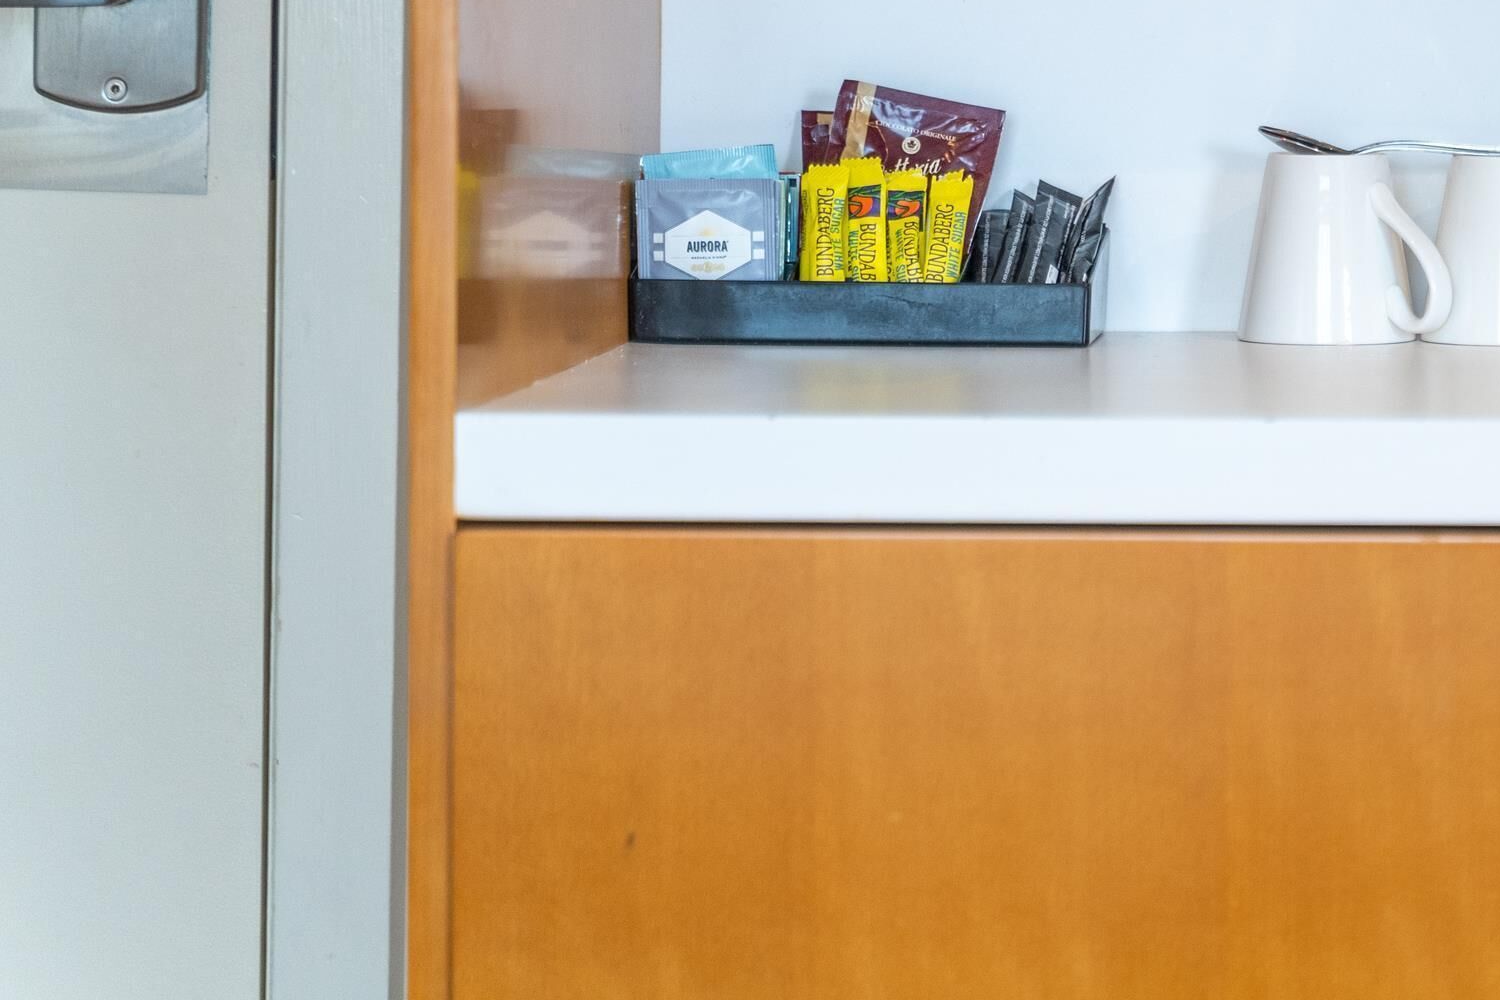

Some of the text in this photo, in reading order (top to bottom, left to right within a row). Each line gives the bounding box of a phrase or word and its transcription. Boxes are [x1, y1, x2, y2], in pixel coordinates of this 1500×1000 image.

[686, 240, 729, 253] AURORA
[816, 187, 835, 277] BUNDABERG
[830, 198, 845, 271] WHITE SUGAR
[926, 204, 954, 283] BUNDABERG
[951, 211, 967, 244] SUGAR
